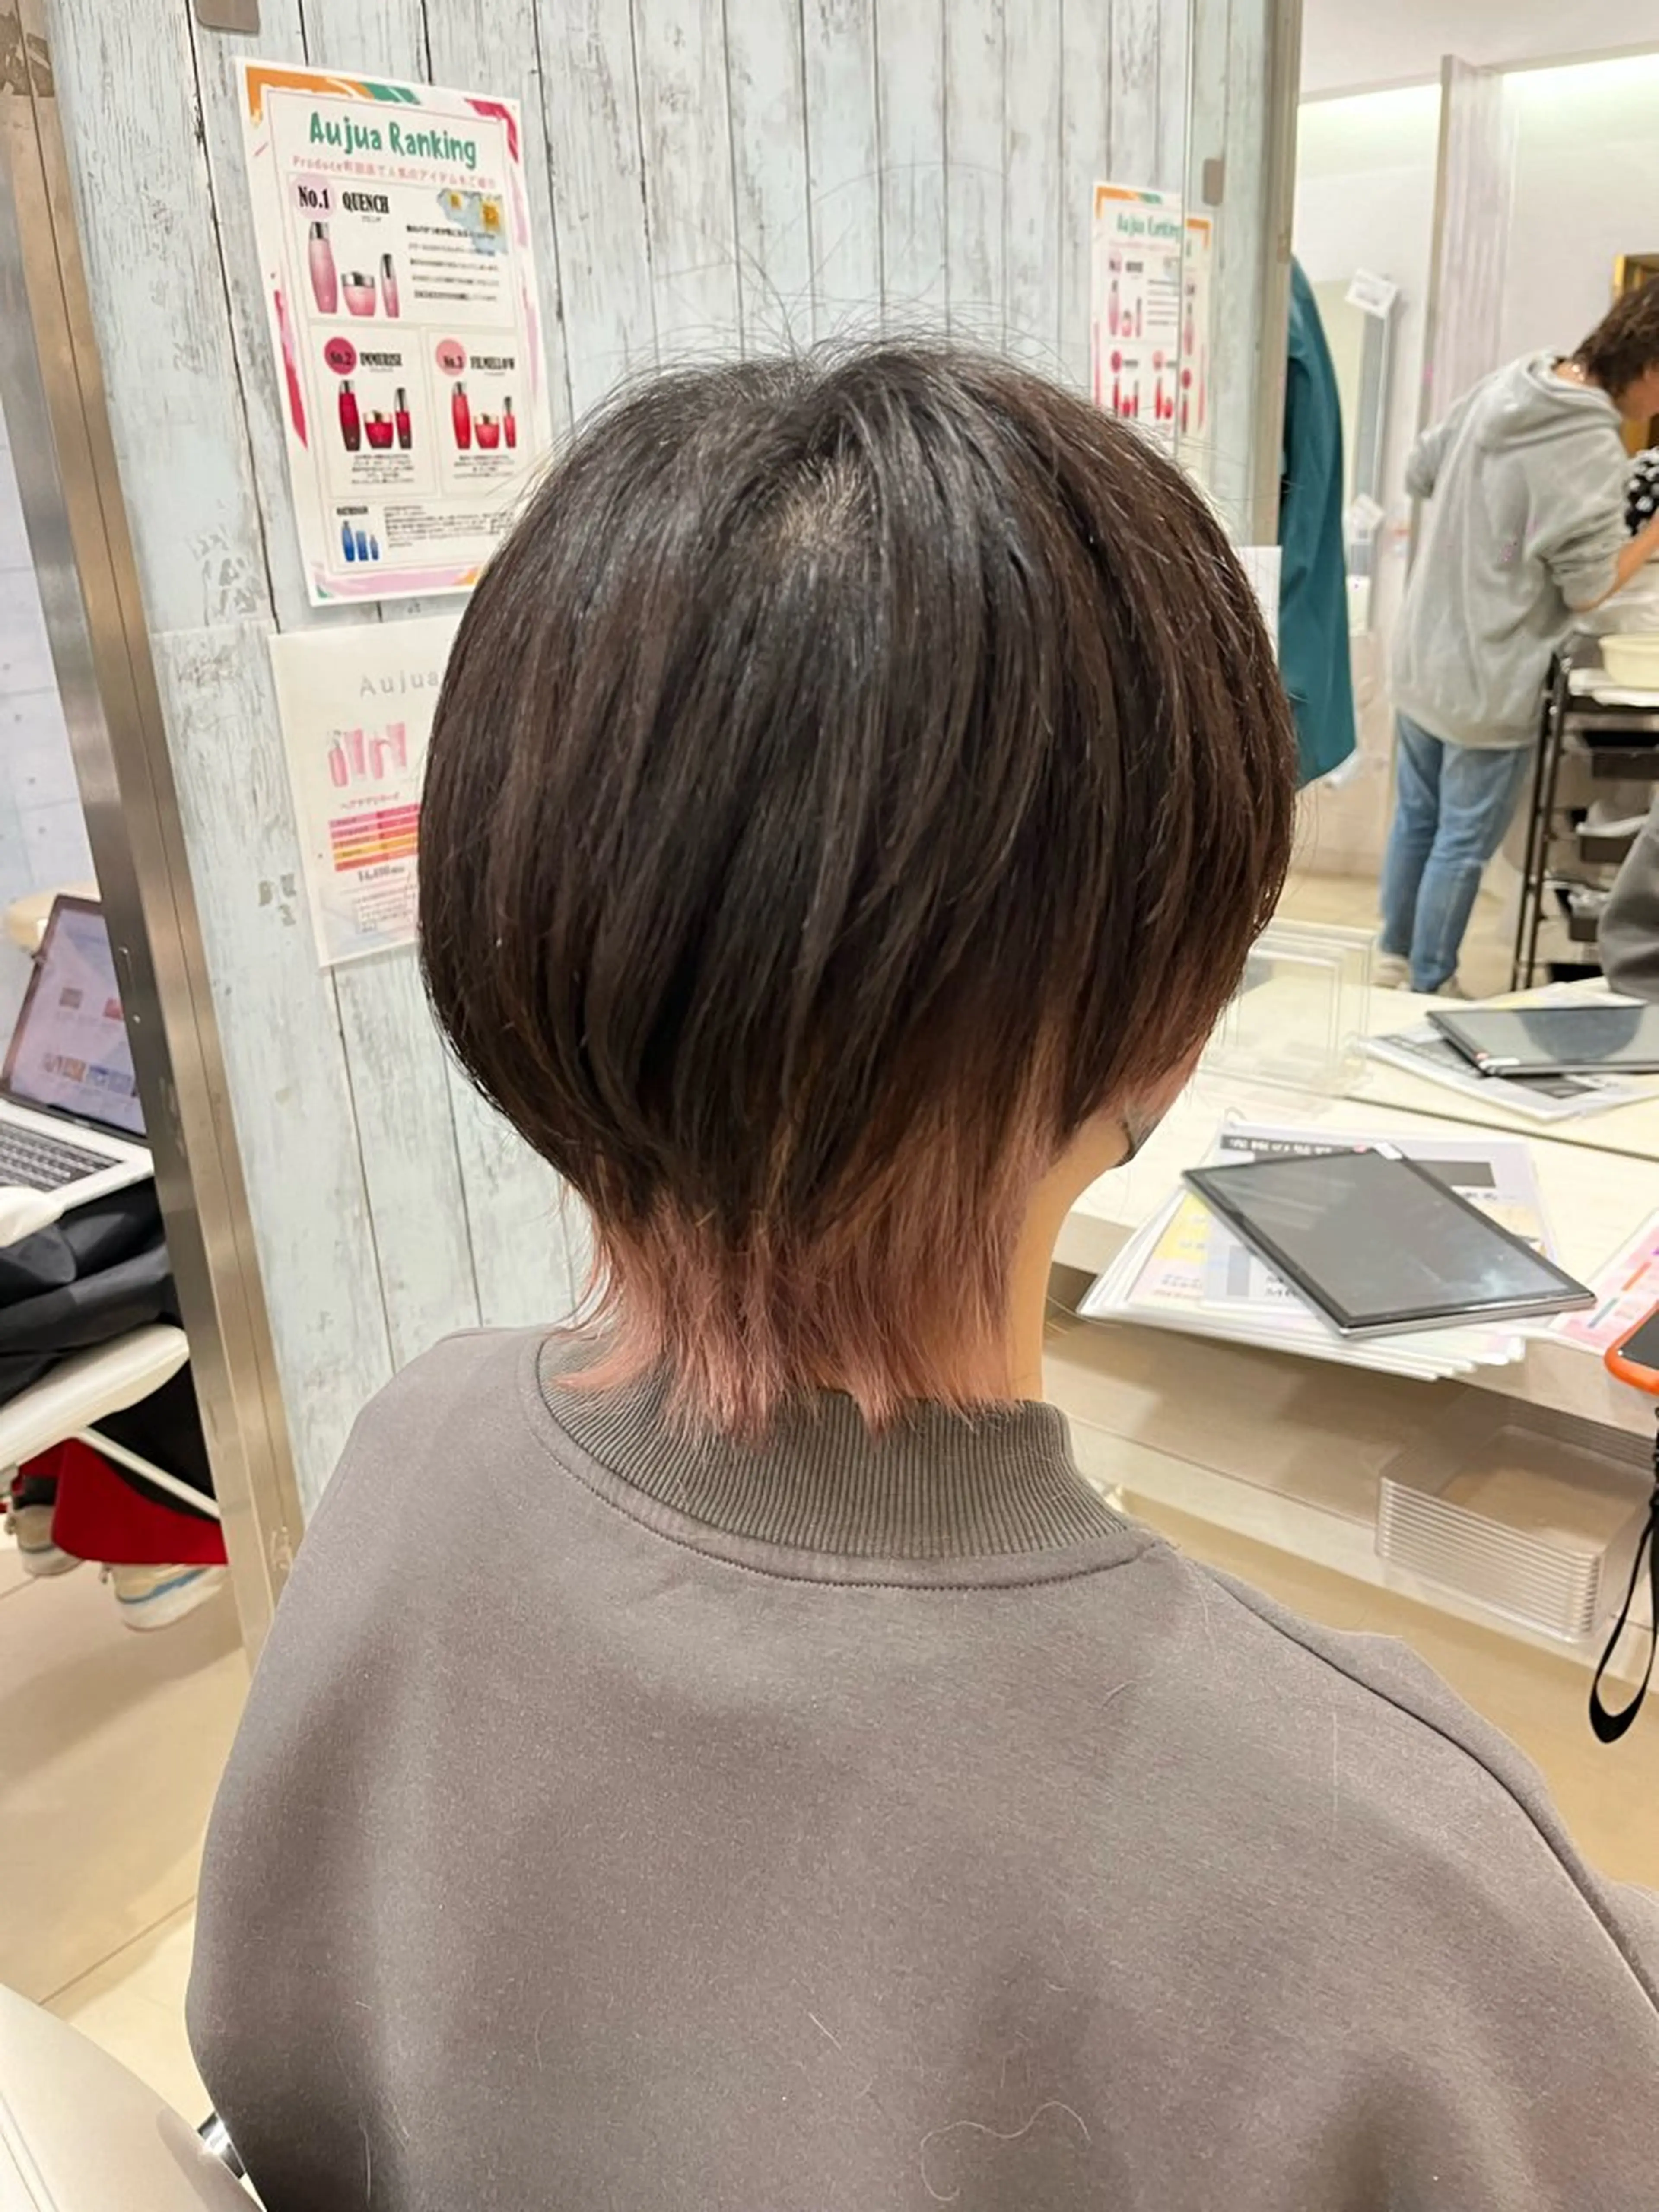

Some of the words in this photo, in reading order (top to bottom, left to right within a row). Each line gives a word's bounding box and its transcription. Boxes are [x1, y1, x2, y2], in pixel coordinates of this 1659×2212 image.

[310, 111, 382, 154] Aujua
[389, 121, 477, 170] Ranking
[342, 191, 390, 214] QUENCH
[360, 668, 439, 698] Aujua
